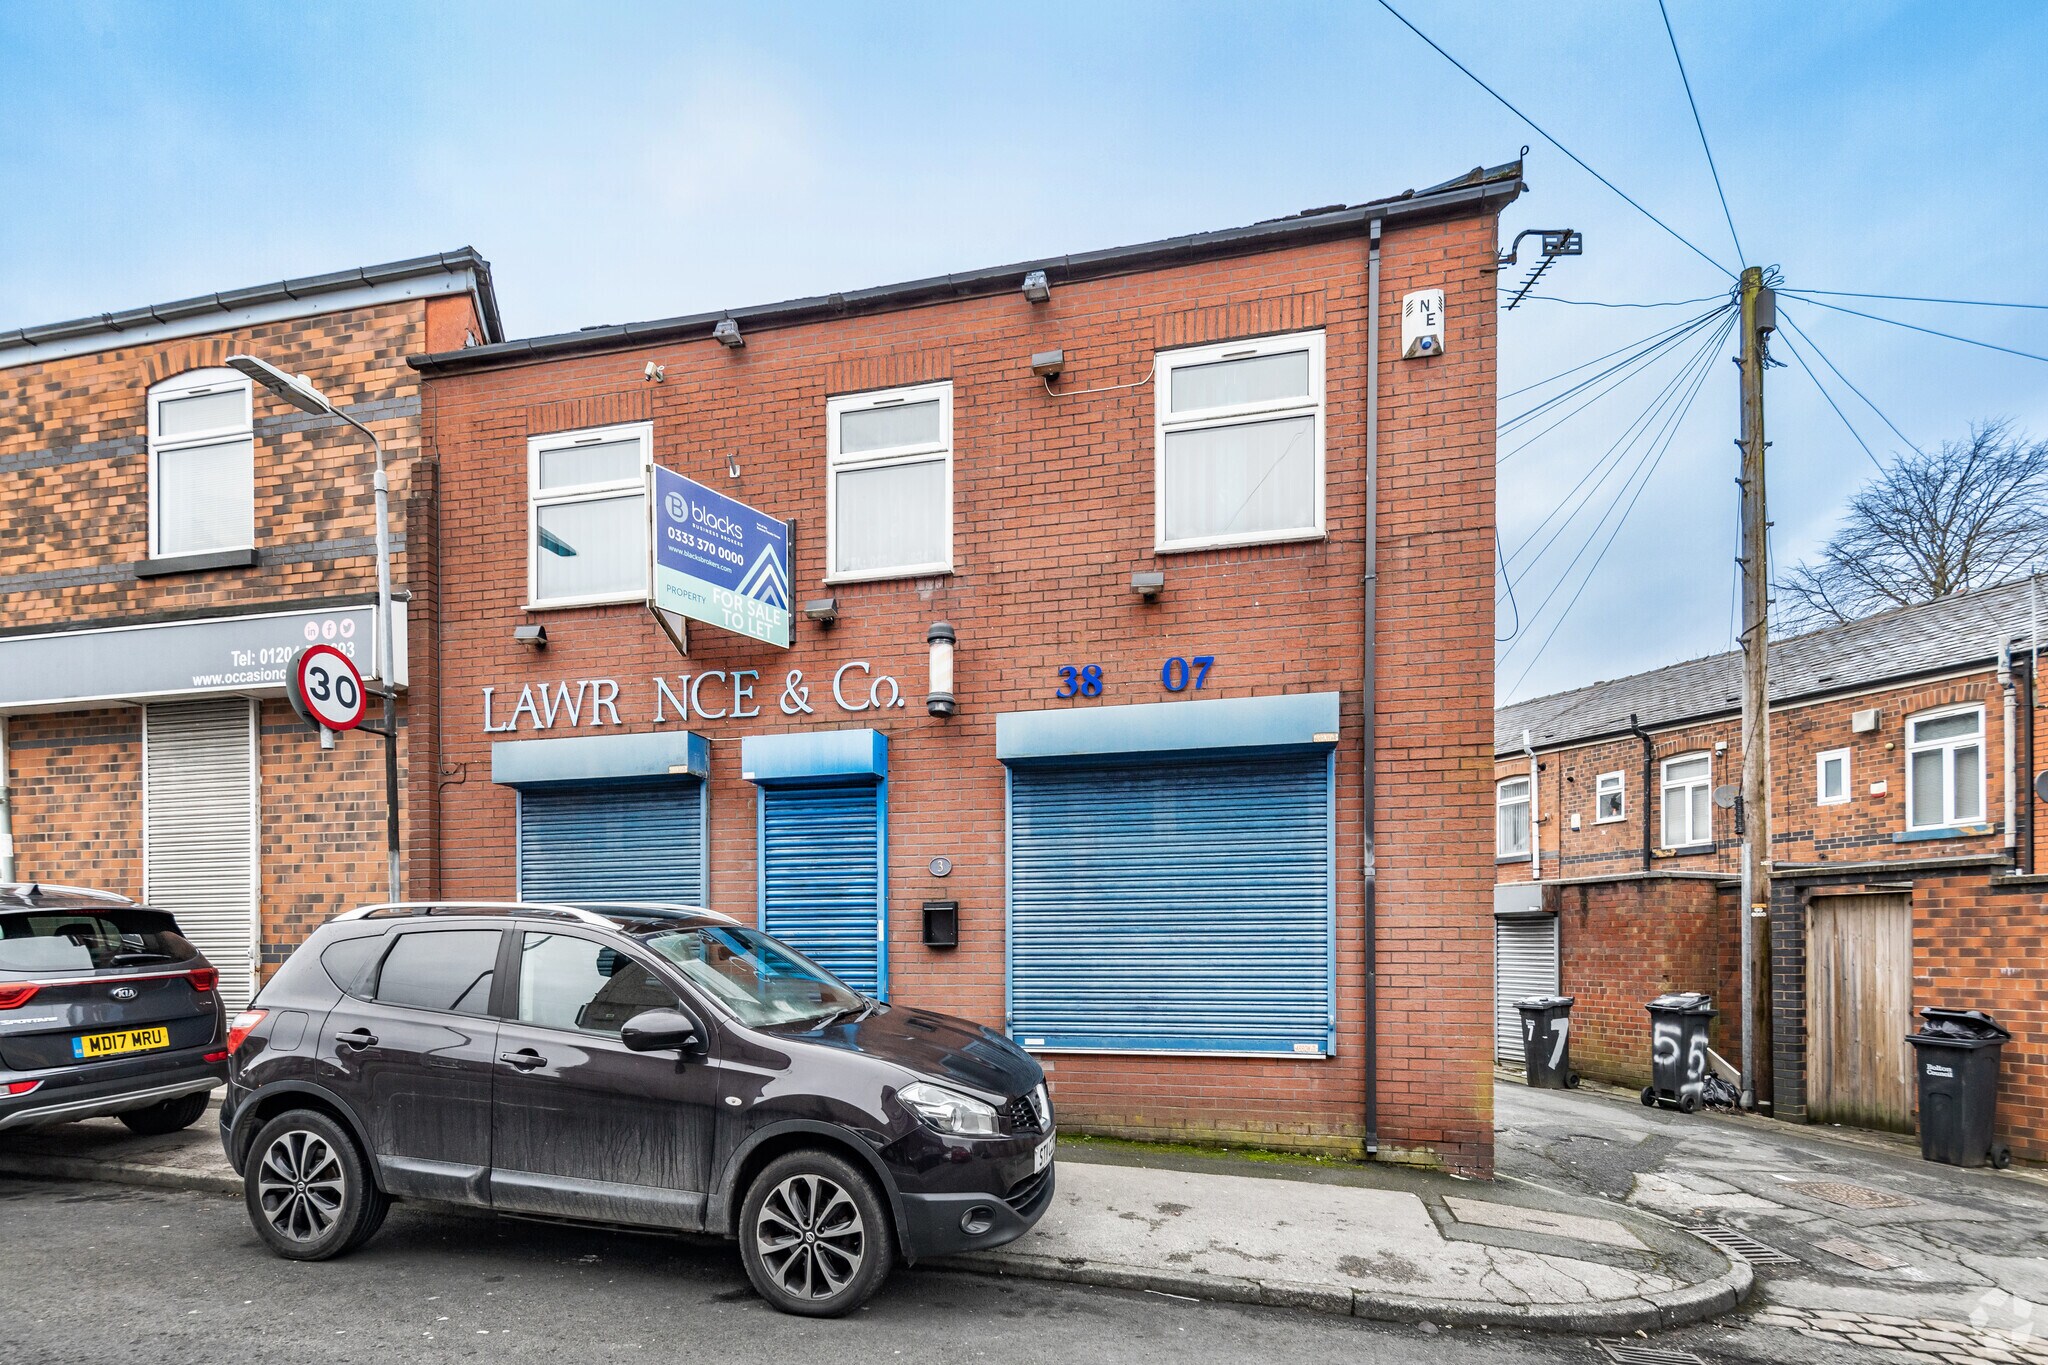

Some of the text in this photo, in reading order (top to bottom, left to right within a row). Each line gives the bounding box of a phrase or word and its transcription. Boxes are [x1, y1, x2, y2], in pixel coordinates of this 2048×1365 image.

[1420, 299, 1430, 313] N
[1426, 312, 1436, 327] E
[691, 500, 743, 540] blacks
[692, 522, 744, 548] BUSINESS BROKERS
[667, 526, 744, 567] 0333 370 0000
[667, 544, 733, 574] www.blacksbrokers.com
[666, 584, 707, 604] PROPERTY
[712, 587, 782, 626] FOR SALE
[721, 608, 774, 640] TO LET
[231, 649, 255, 667] Tel:
[309, 666, 357, 709] 30
[780, 669, 814, 715] &
[832, 661, 905, 712] Co.
[1056, 656, 1215, 699] 38 07
[937, 860, 944, 872] 3
[118, 989, 135, 998] KIA
[89, 1034, 126, 1053] MD17
[131, 1029, 162, 1047] MRU
[1548, 1018, 1569, 1070] 7
